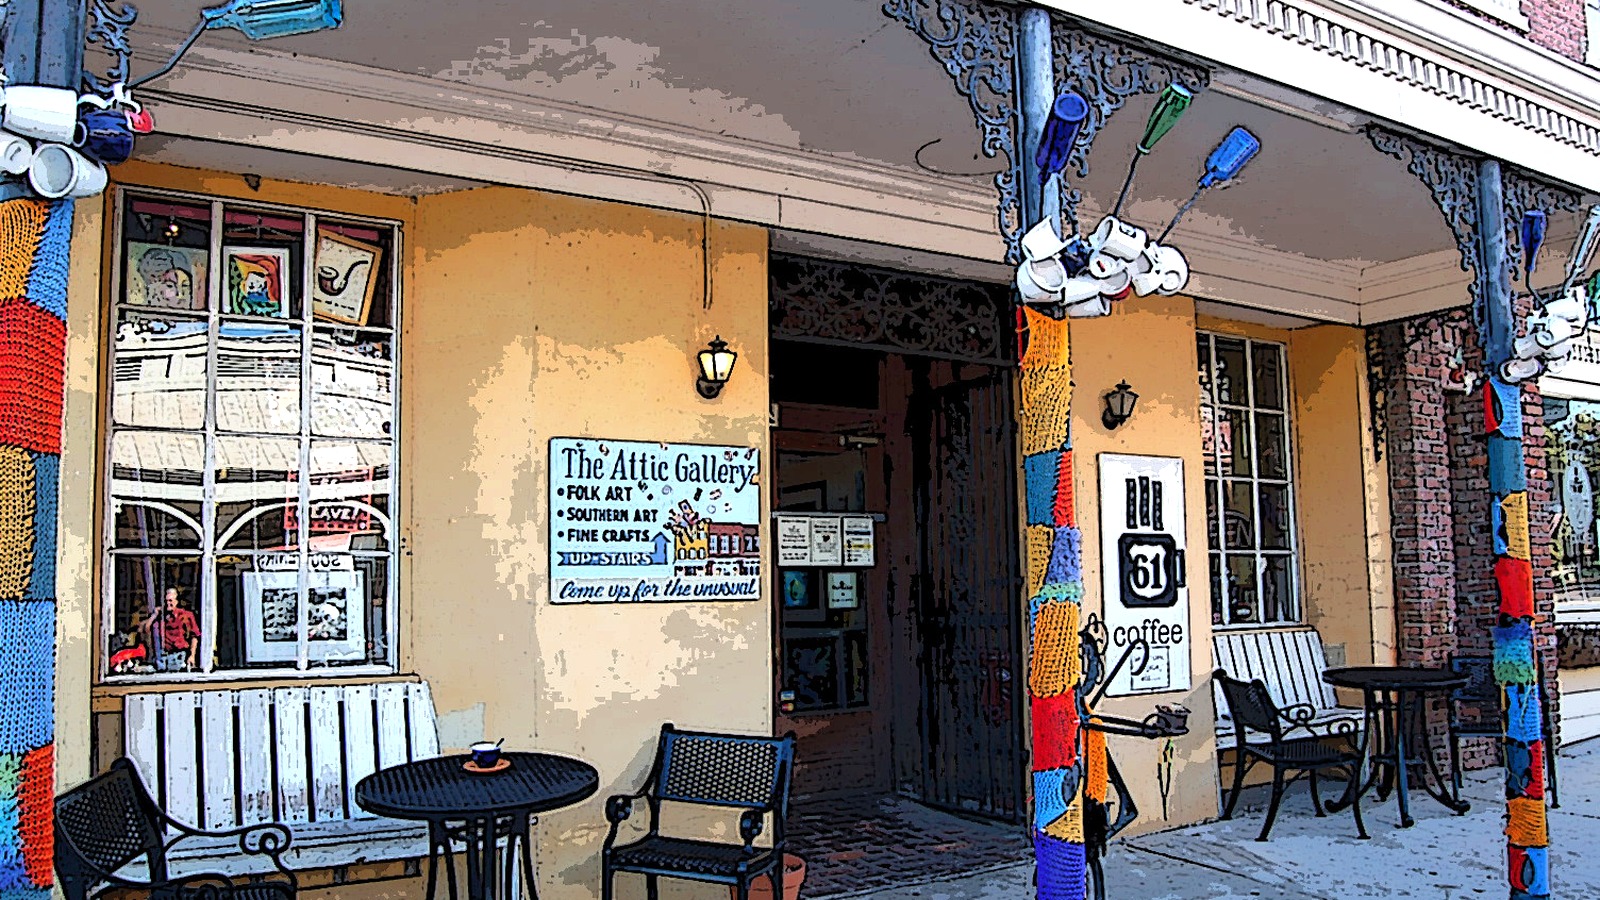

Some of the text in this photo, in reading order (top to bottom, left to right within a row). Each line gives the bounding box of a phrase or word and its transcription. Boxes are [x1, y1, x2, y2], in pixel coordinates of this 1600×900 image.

[561, 447, 756, 493] The Attic Gallery
[566, 485, 633, 501] FOLK ART
[566, 507, 658, 522] SOUTHERN ART
[567, 528, 650, 543] FINE CRAFTS
[1132, 552, 1163, 589] 61
[559, 578, 757, 602] Come up for the unusual
[1113, 618, 1183, 648] coffee
